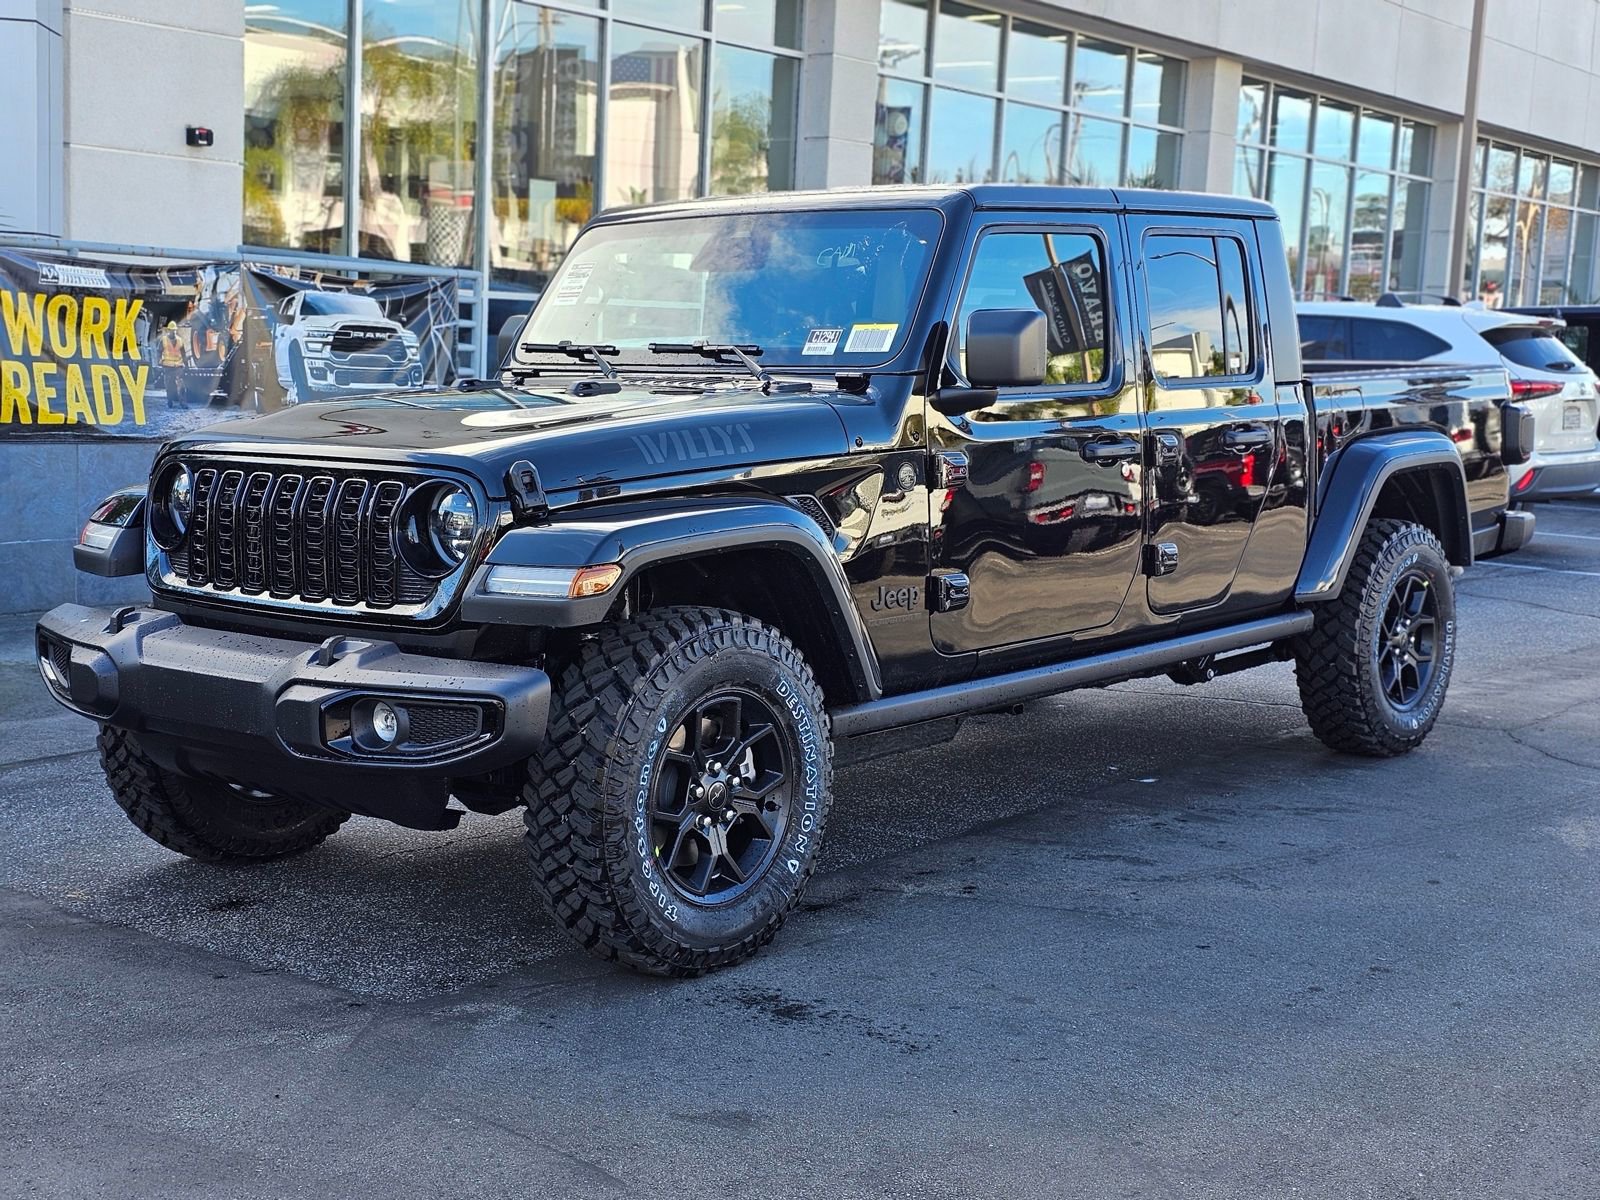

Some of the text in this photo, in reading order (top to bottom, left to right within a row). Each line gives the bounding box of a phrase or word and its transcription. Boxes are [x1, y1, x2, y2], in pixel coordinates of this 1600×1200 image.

[0, 290, 144, 360] WORK
[353, 331, 387, 340] RAM
[0, 360, 149, 426] READY
[631, 423, 755, 465] WILLYS
[871, 586, 920, 612] Jeep
[776, 680, 818, 853] DESTINATION
